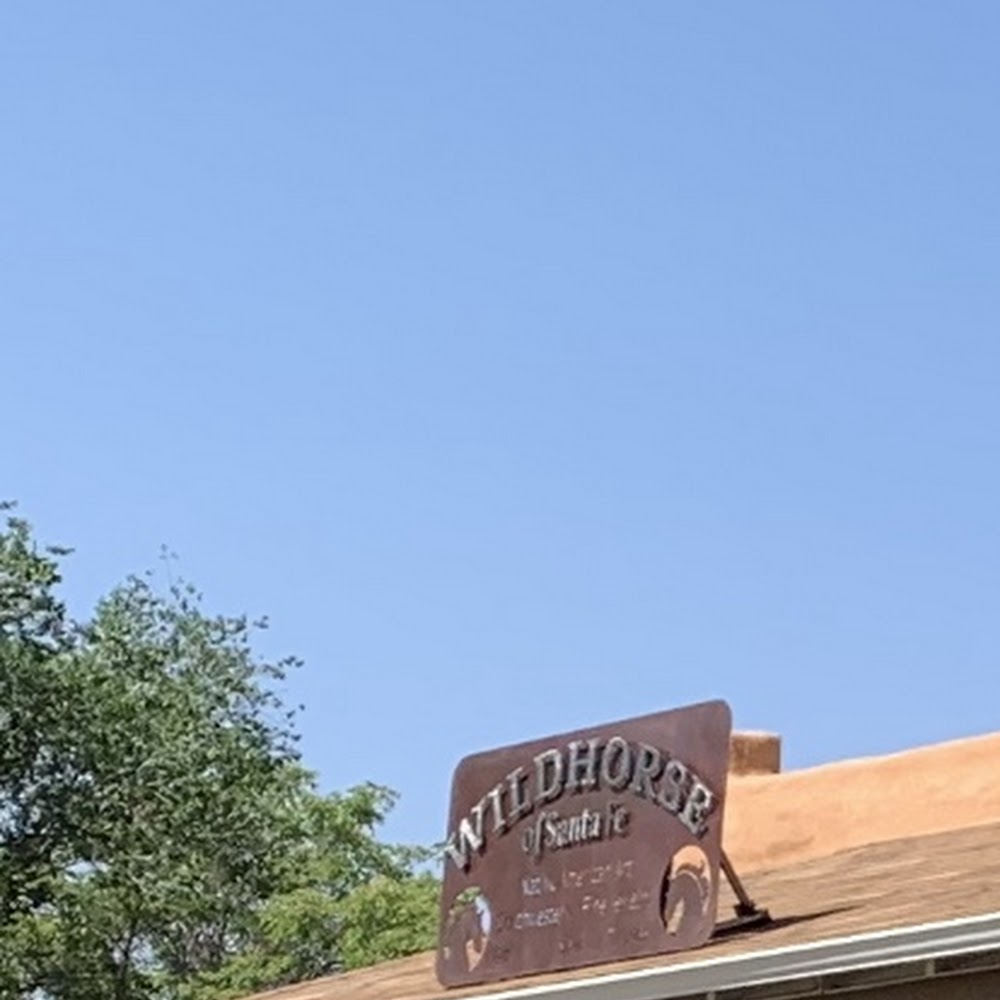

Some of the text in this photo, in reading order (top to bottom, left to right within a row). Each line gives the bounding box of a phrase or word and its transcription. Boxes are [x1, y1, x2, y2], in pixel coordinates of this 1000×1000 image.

[447, 736, 715, 872] WILDHORSE
[522, 811, 546, 861] of
[544, 810, 600, 848] Santa
